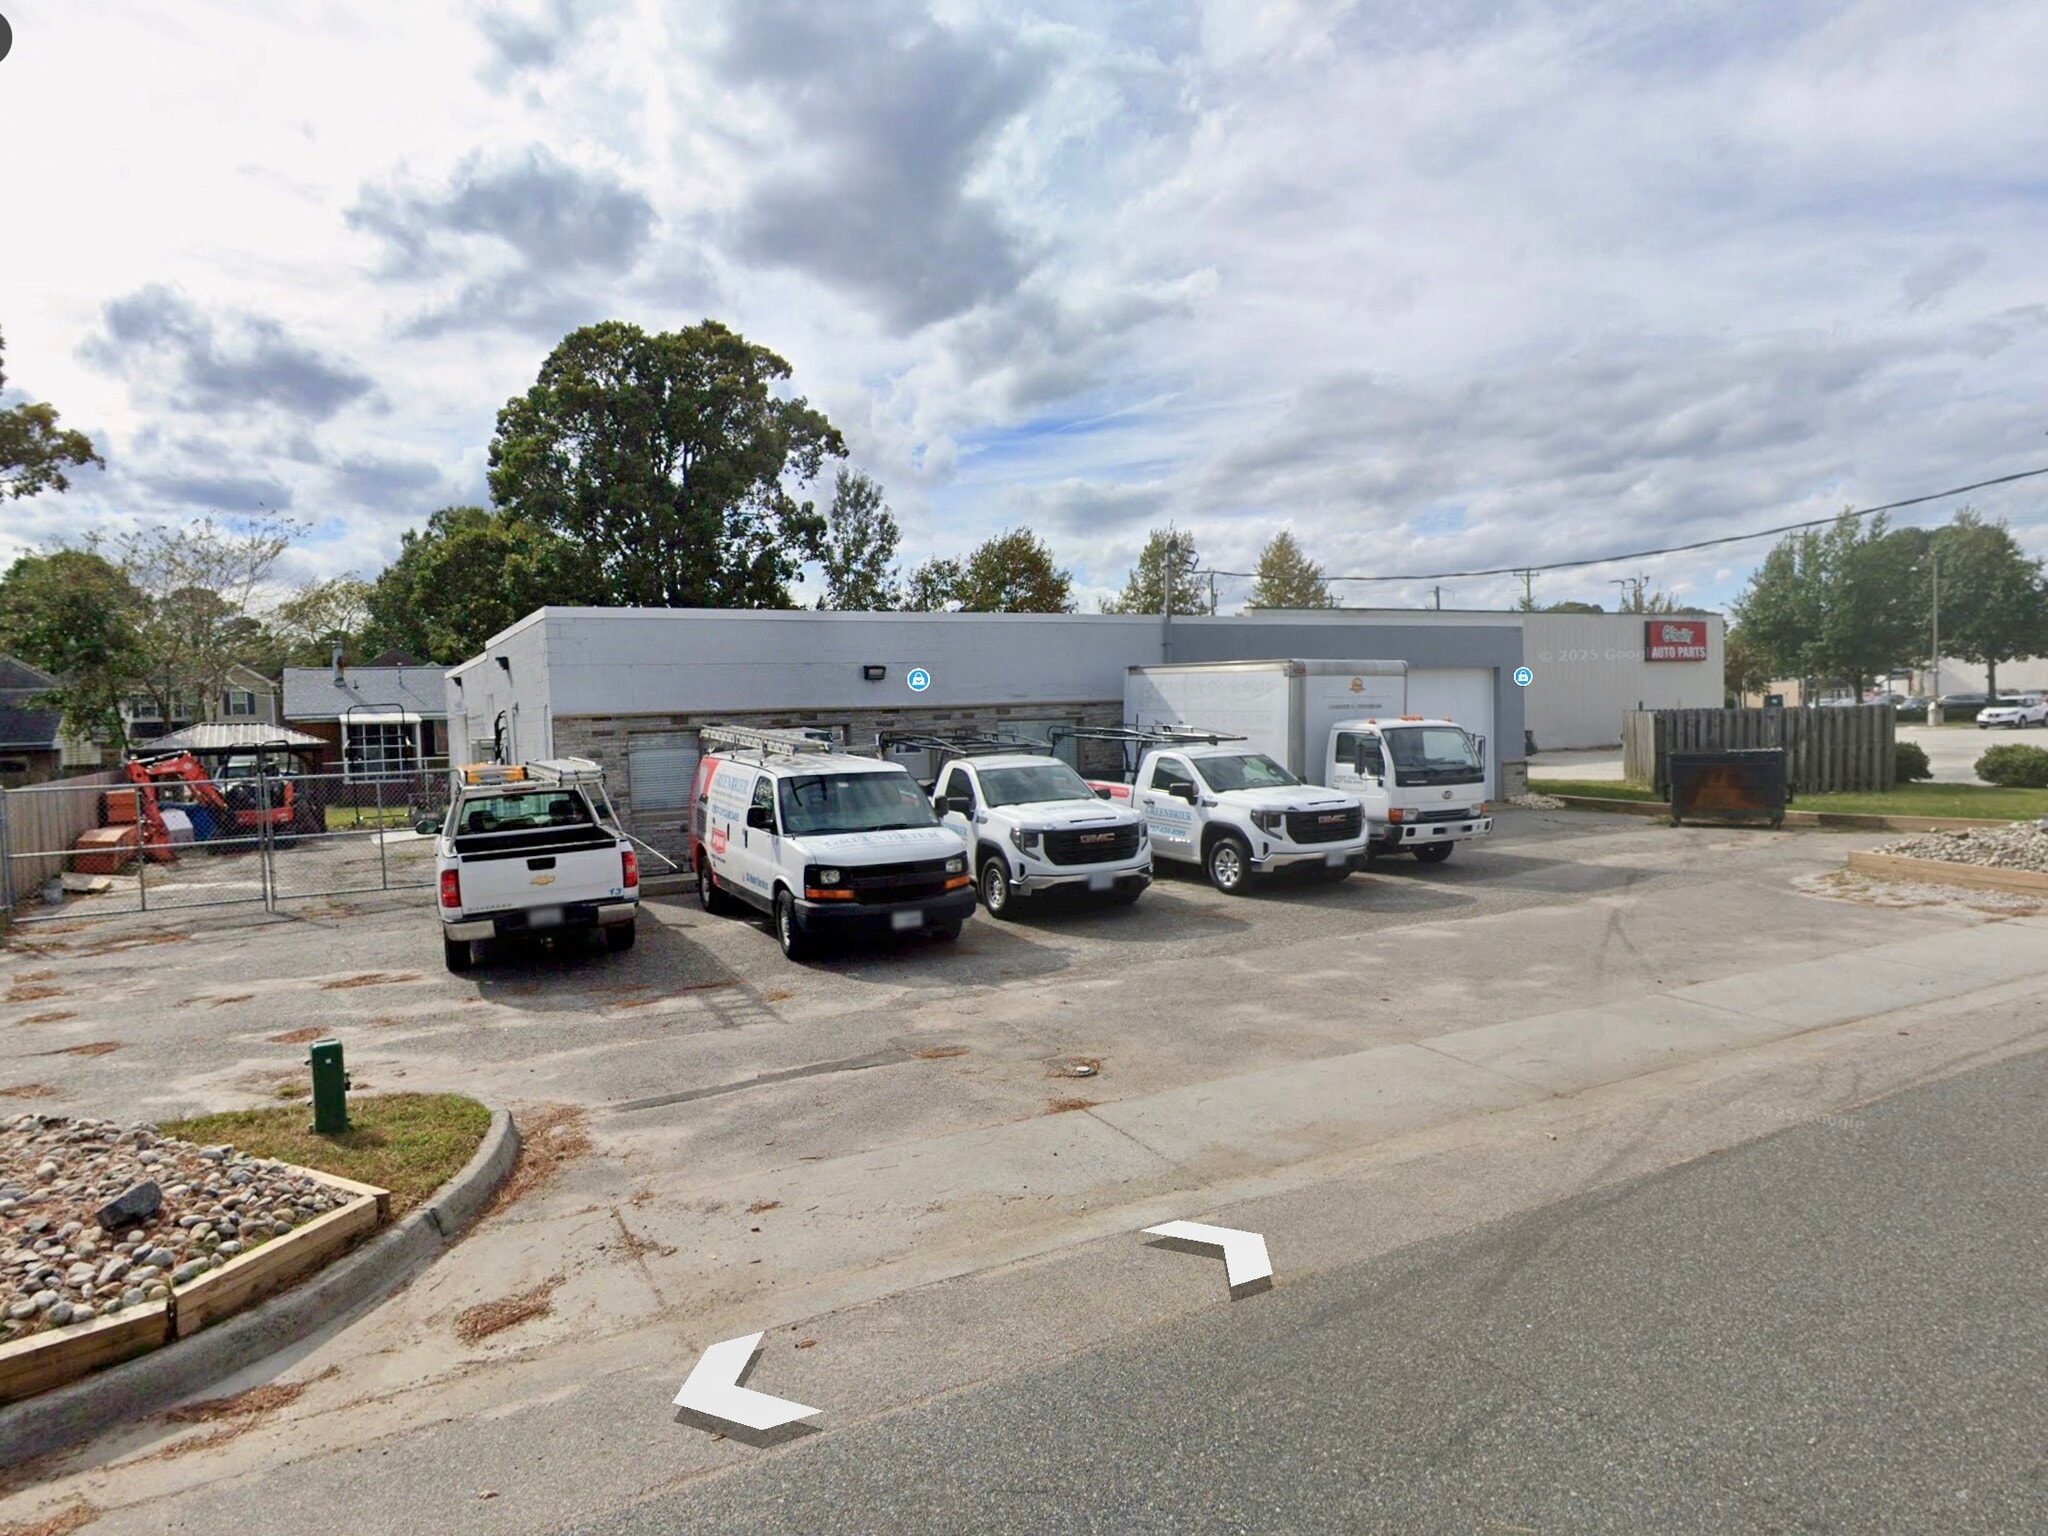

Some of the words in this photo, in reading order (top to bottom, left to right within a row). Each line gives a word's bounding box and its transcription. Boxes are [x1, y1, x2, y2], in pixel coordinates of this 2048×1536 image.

[1651, 646, 1675, 659] AUTO
[1677, 646, 1706, 659] PARTS
[1318, 814, 1347, 825] GMC
[1080, 832, 1116, 844] GMC
